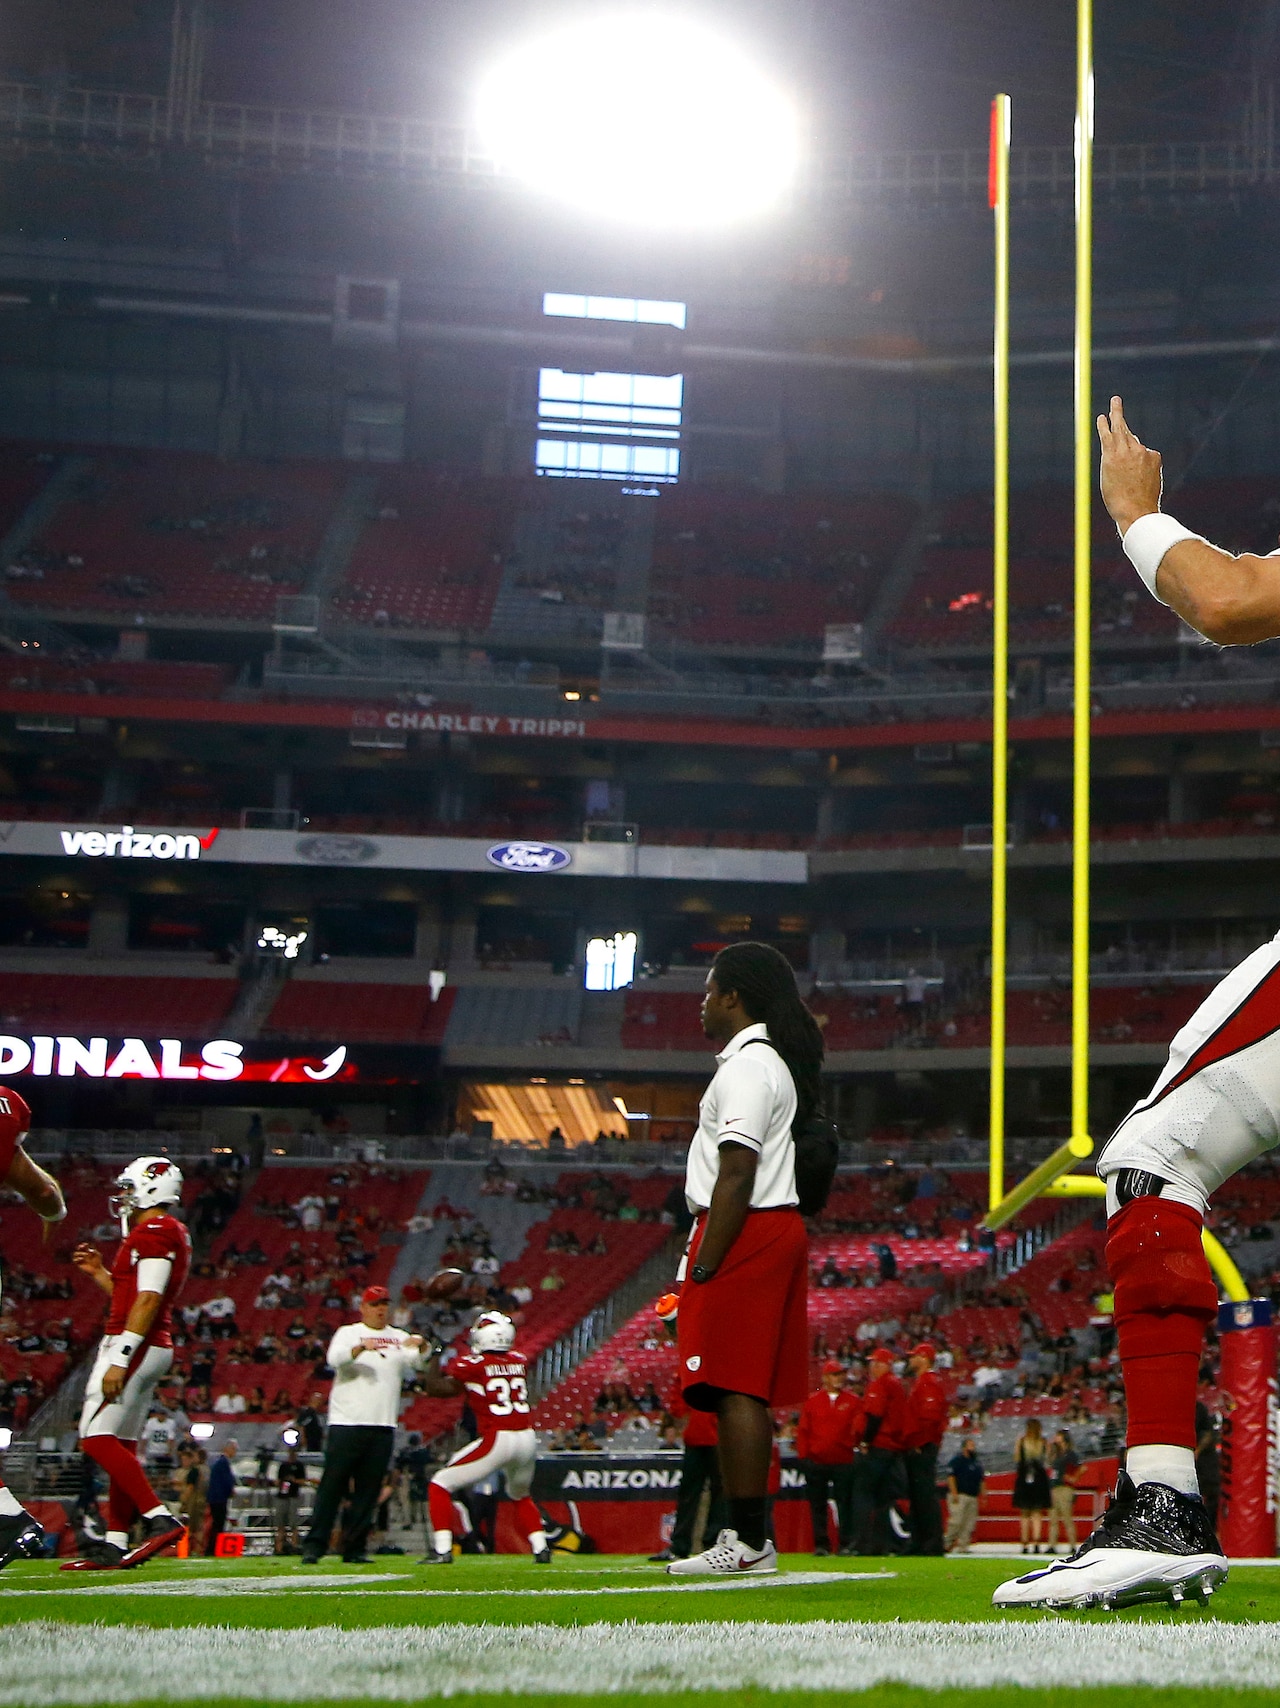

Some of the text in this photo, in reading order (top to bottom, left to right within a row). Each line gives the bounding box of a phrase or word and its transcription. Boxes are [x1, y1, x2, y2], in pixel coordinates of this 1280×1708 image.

[385, 711, 500, 733] CHARLEY
[508, 717, 586, 736] TRIPPI
[60, 826, 200, 860] verizon
[501, 843, 556, 867] Ford
[0, 1034, 243, 1081] DINALS
[485, 1377, 531, 1416] 33
[222, 1535, 238, 1554] G
